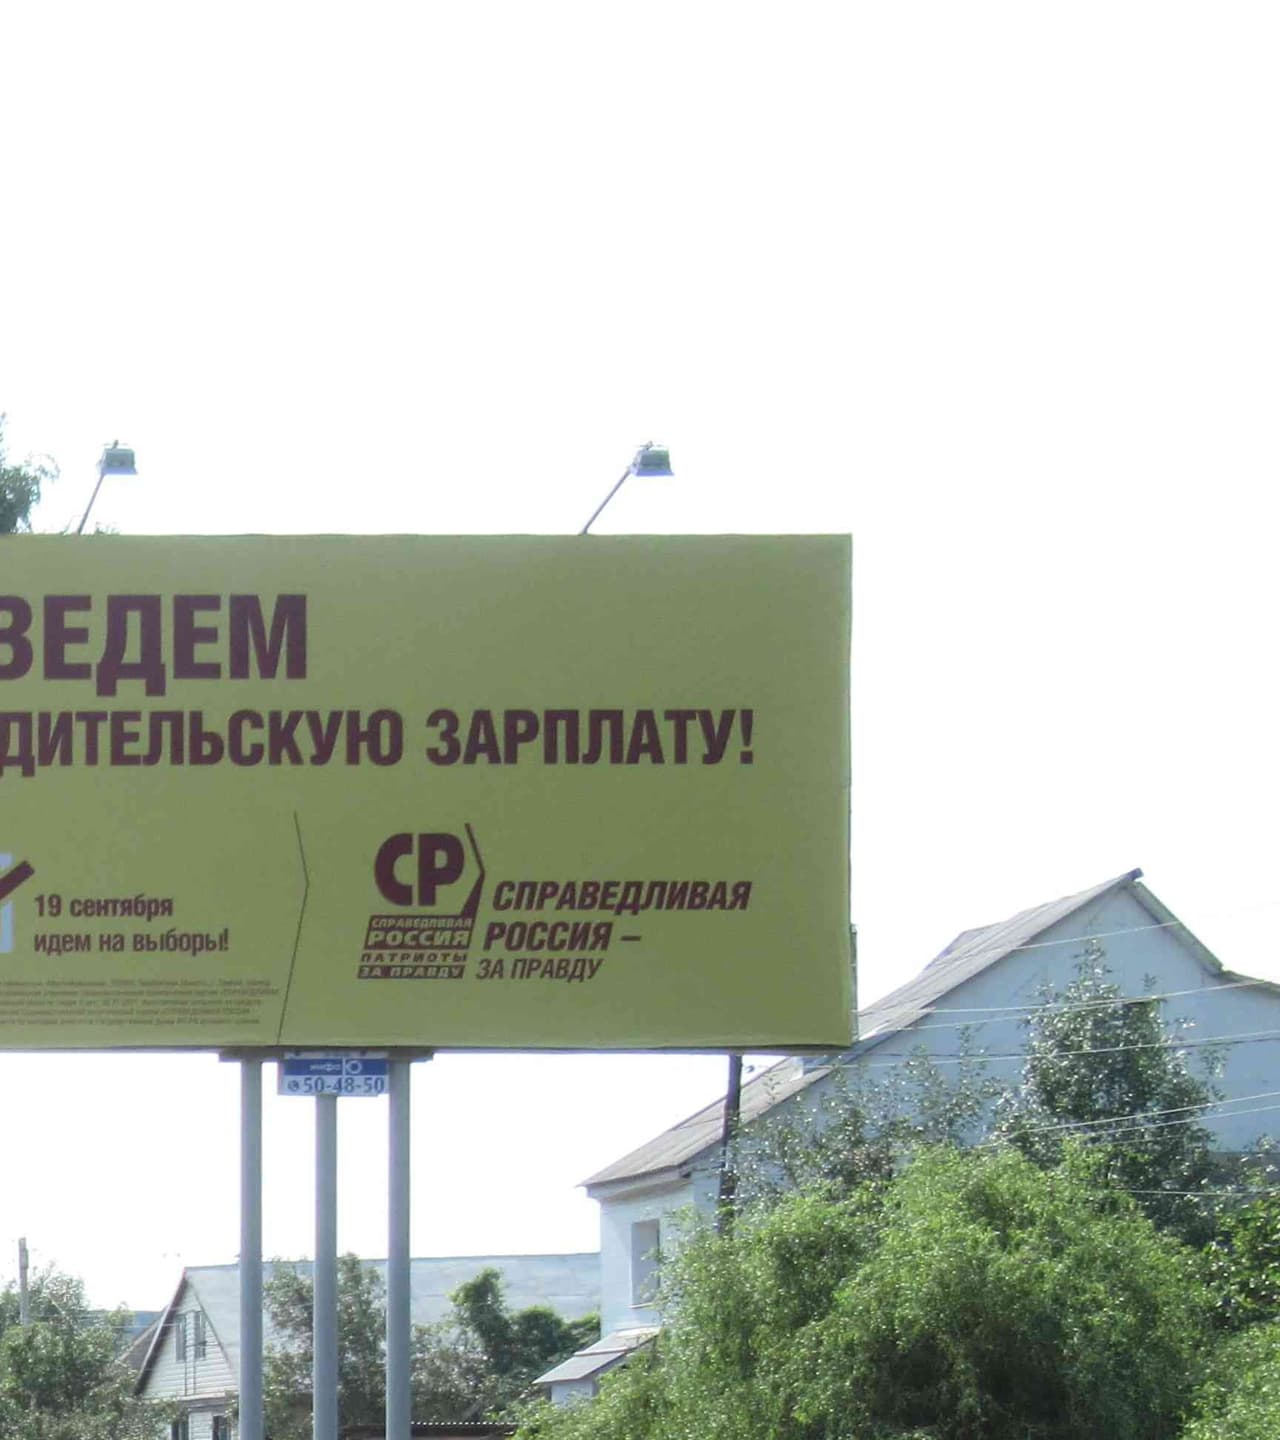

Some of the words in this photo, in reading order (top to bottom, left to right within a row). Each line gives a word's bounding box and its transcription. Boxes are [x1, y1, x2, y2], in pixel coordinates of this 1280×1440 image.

[427, 709, 753, 765] ЗАРПЛАТУ!
[375, 833, 465, 906] СР
[35, 894, 61, 917] 19
[70, 893, 173, 922] сентября
[493, 881, 752, 915] СПРАВЕДЛИВАЯ
[34, 933, 91, 956] идем
[99, 934, 125, 952] на
[133, 928, 229, 956] выборы!
[367, 931, 469, 946] РОССИЯ
[484, 922, 613, 951] РОССИЯ
[361, 952, 468, 963] ПАТРИОТЫ
[476, 959, 504, 980] ЗА
[510, 958, 603, 983] ПРАВДУ
[360, 967, 384, 979] ЗА
[303, 1076, 385, 1093] 50-48-50
